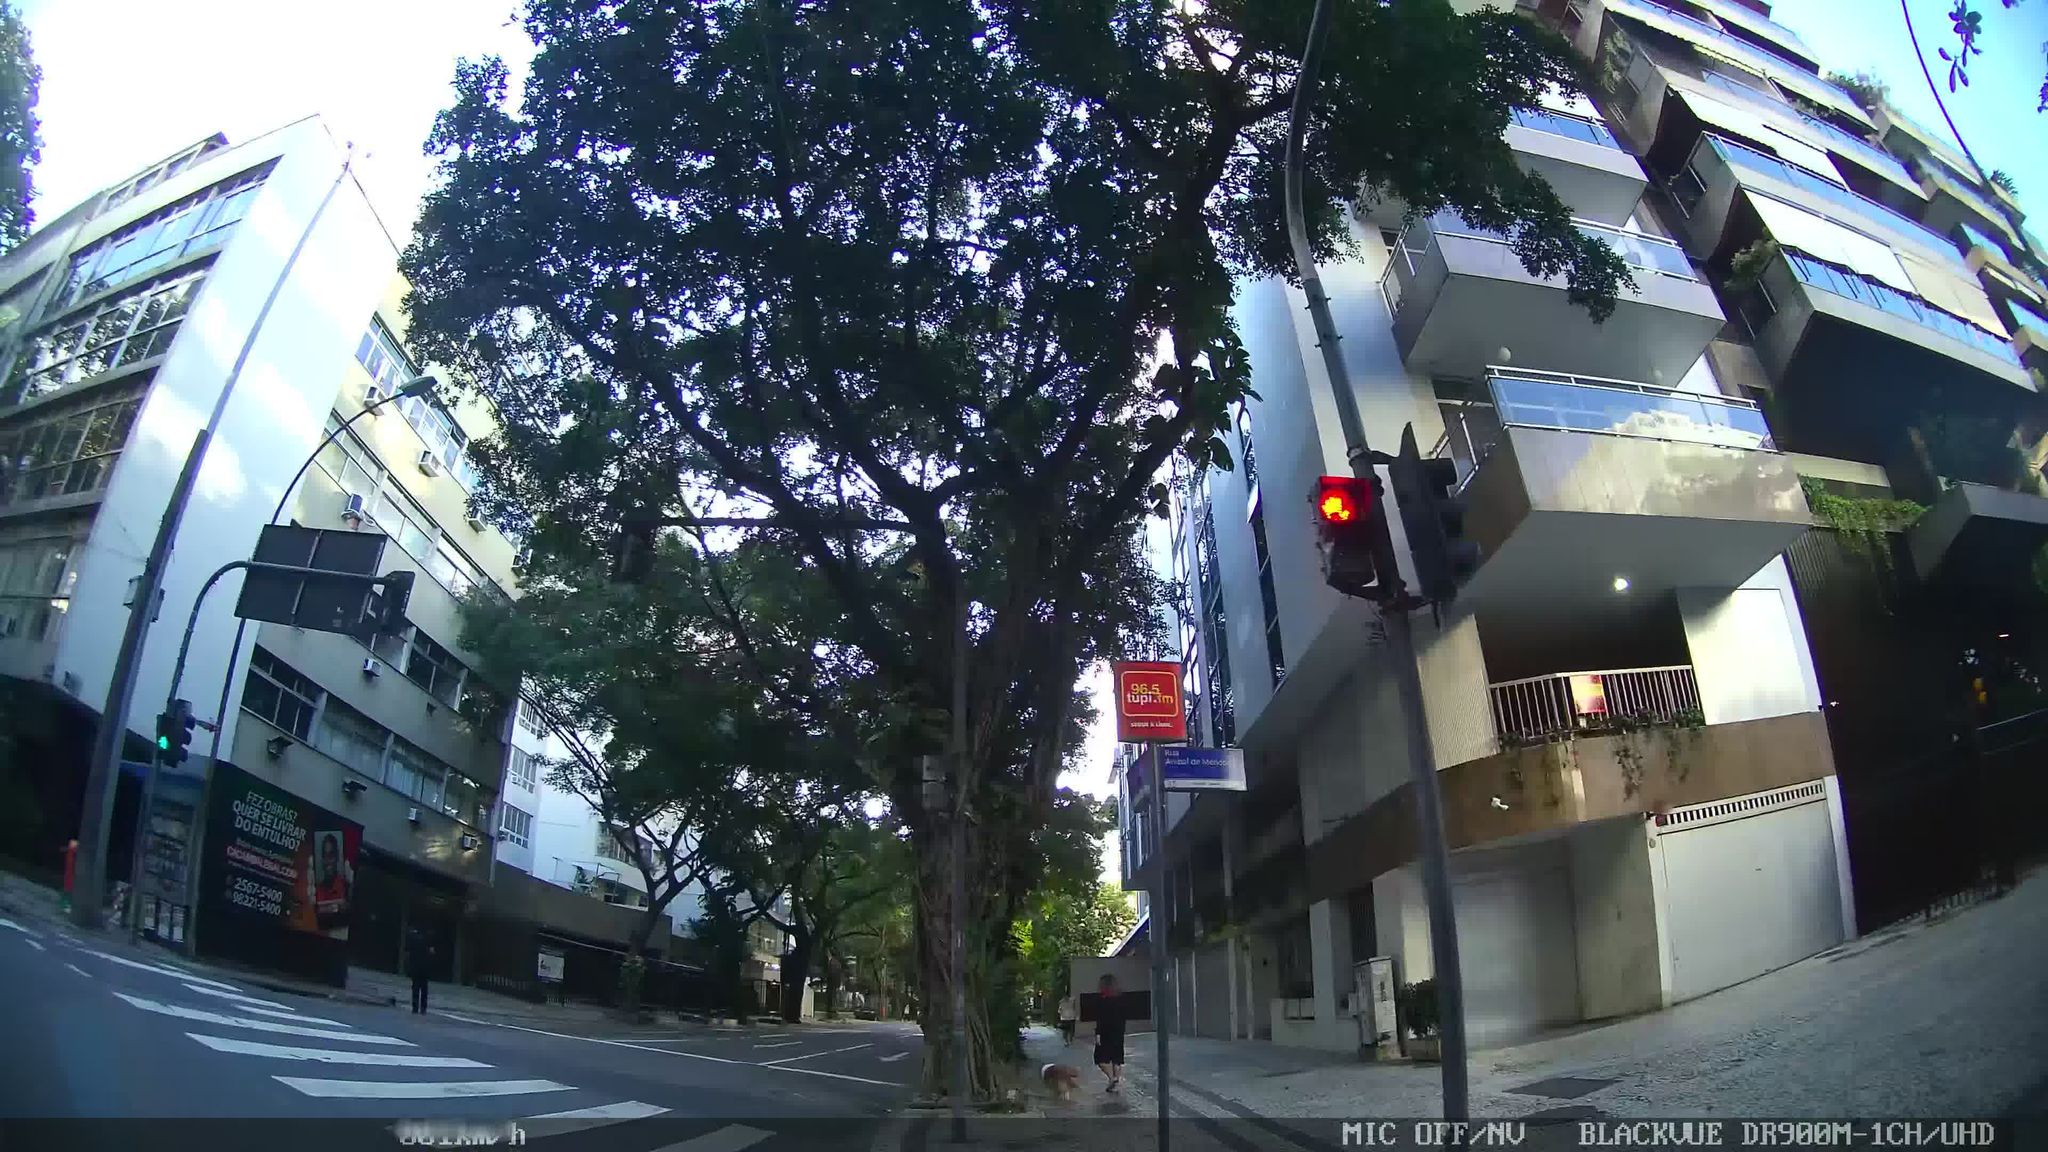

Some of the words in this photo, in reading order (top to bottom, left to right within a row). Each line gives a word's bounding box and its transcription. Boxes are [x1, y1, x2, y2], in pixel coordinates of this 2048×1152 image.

[1126, 691, 1174, 705] tupi.fm
[1131, 683, 1161, 695] 96.5
[232, 799, 261, 821] QUER
[260, 812, 273, 827] SE
[272, 817, 306, 841] LIVRAR
[246, 791, 265, 809] FEZ
[264, 799, 298, 823] OBRAS?
[234, 815, 252, 832] DO
[251, 823, 301, 852] ENTULHO?
